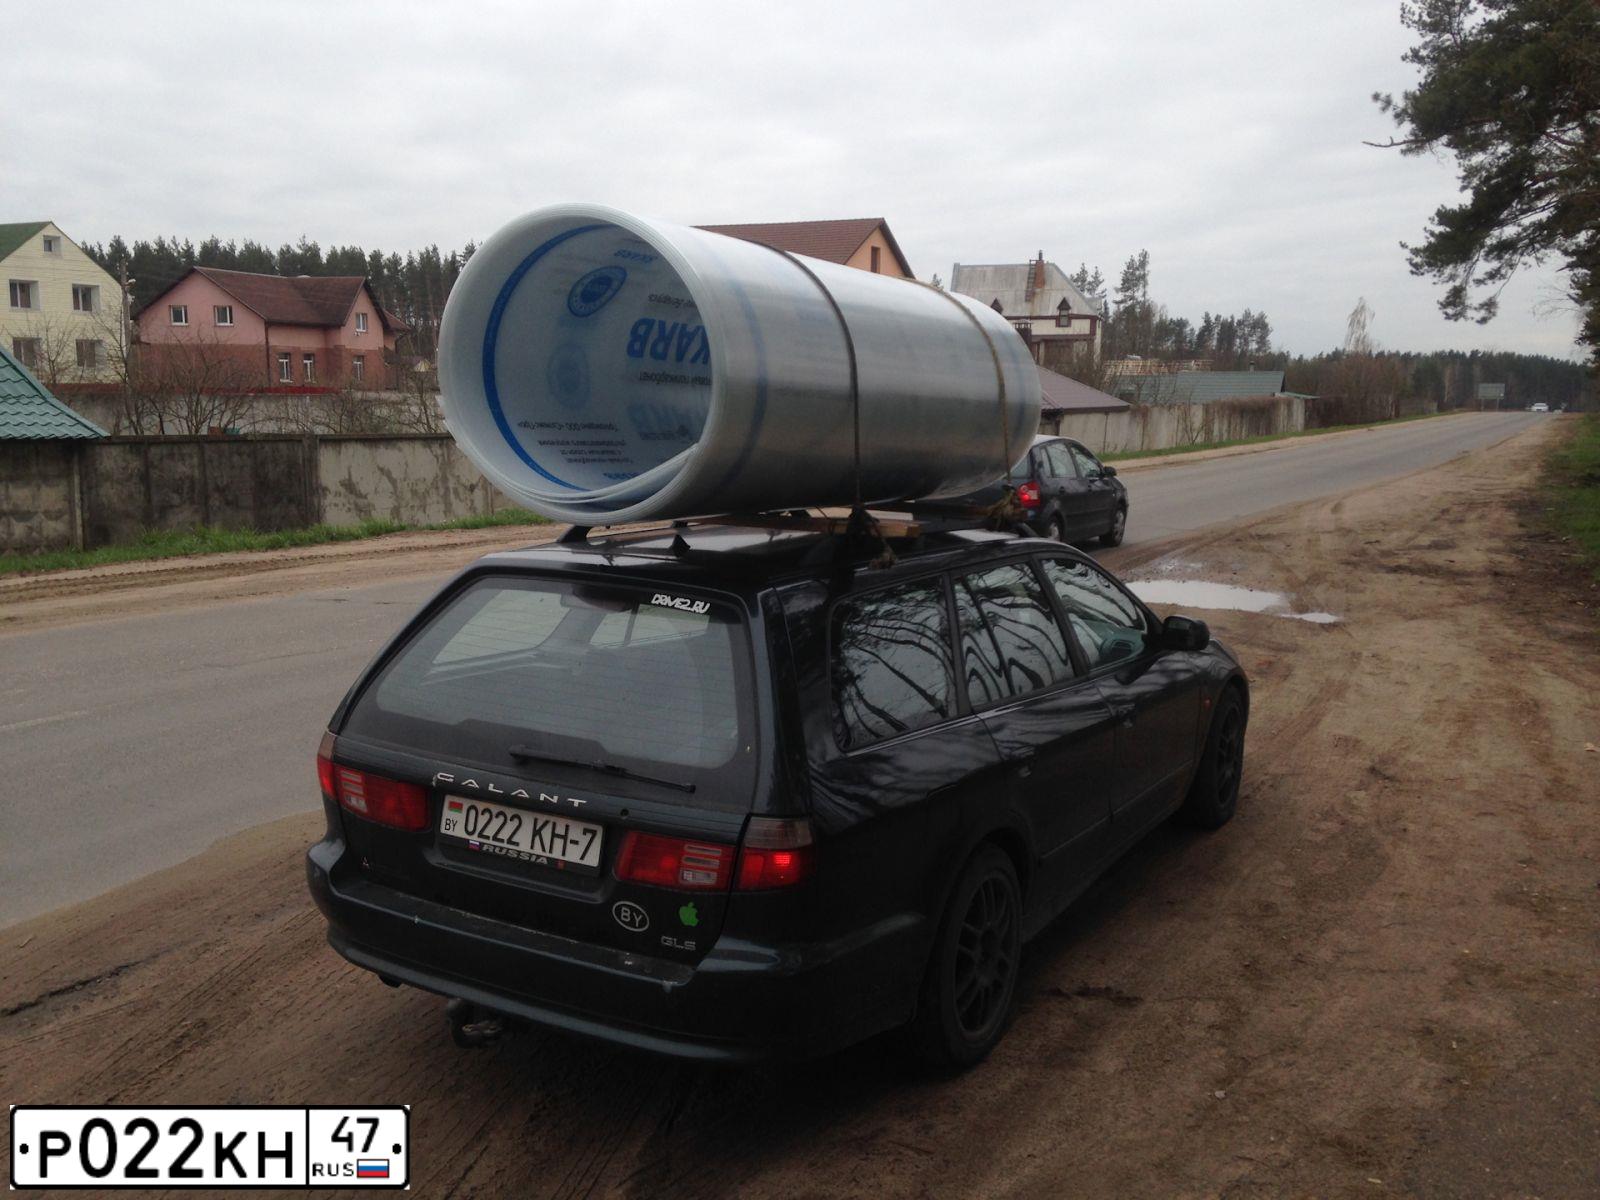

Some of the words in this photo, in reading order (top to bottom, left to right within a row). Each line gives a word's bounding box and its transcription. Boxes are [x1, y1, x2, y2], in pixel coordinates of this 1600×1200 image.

[651, 594, 710, 614] DRIVE2.RU
[436, 772, 587, 807] GALANT
[444, 818, 458, 832] BY
[464, 804, 523, 847] 0222
[530, 817, 598, 861] KH-7
[482, 844, 548, 865] RUSSIA
[620, 906, 643, 928] BY
[661, 935, 696, 951] GLS
